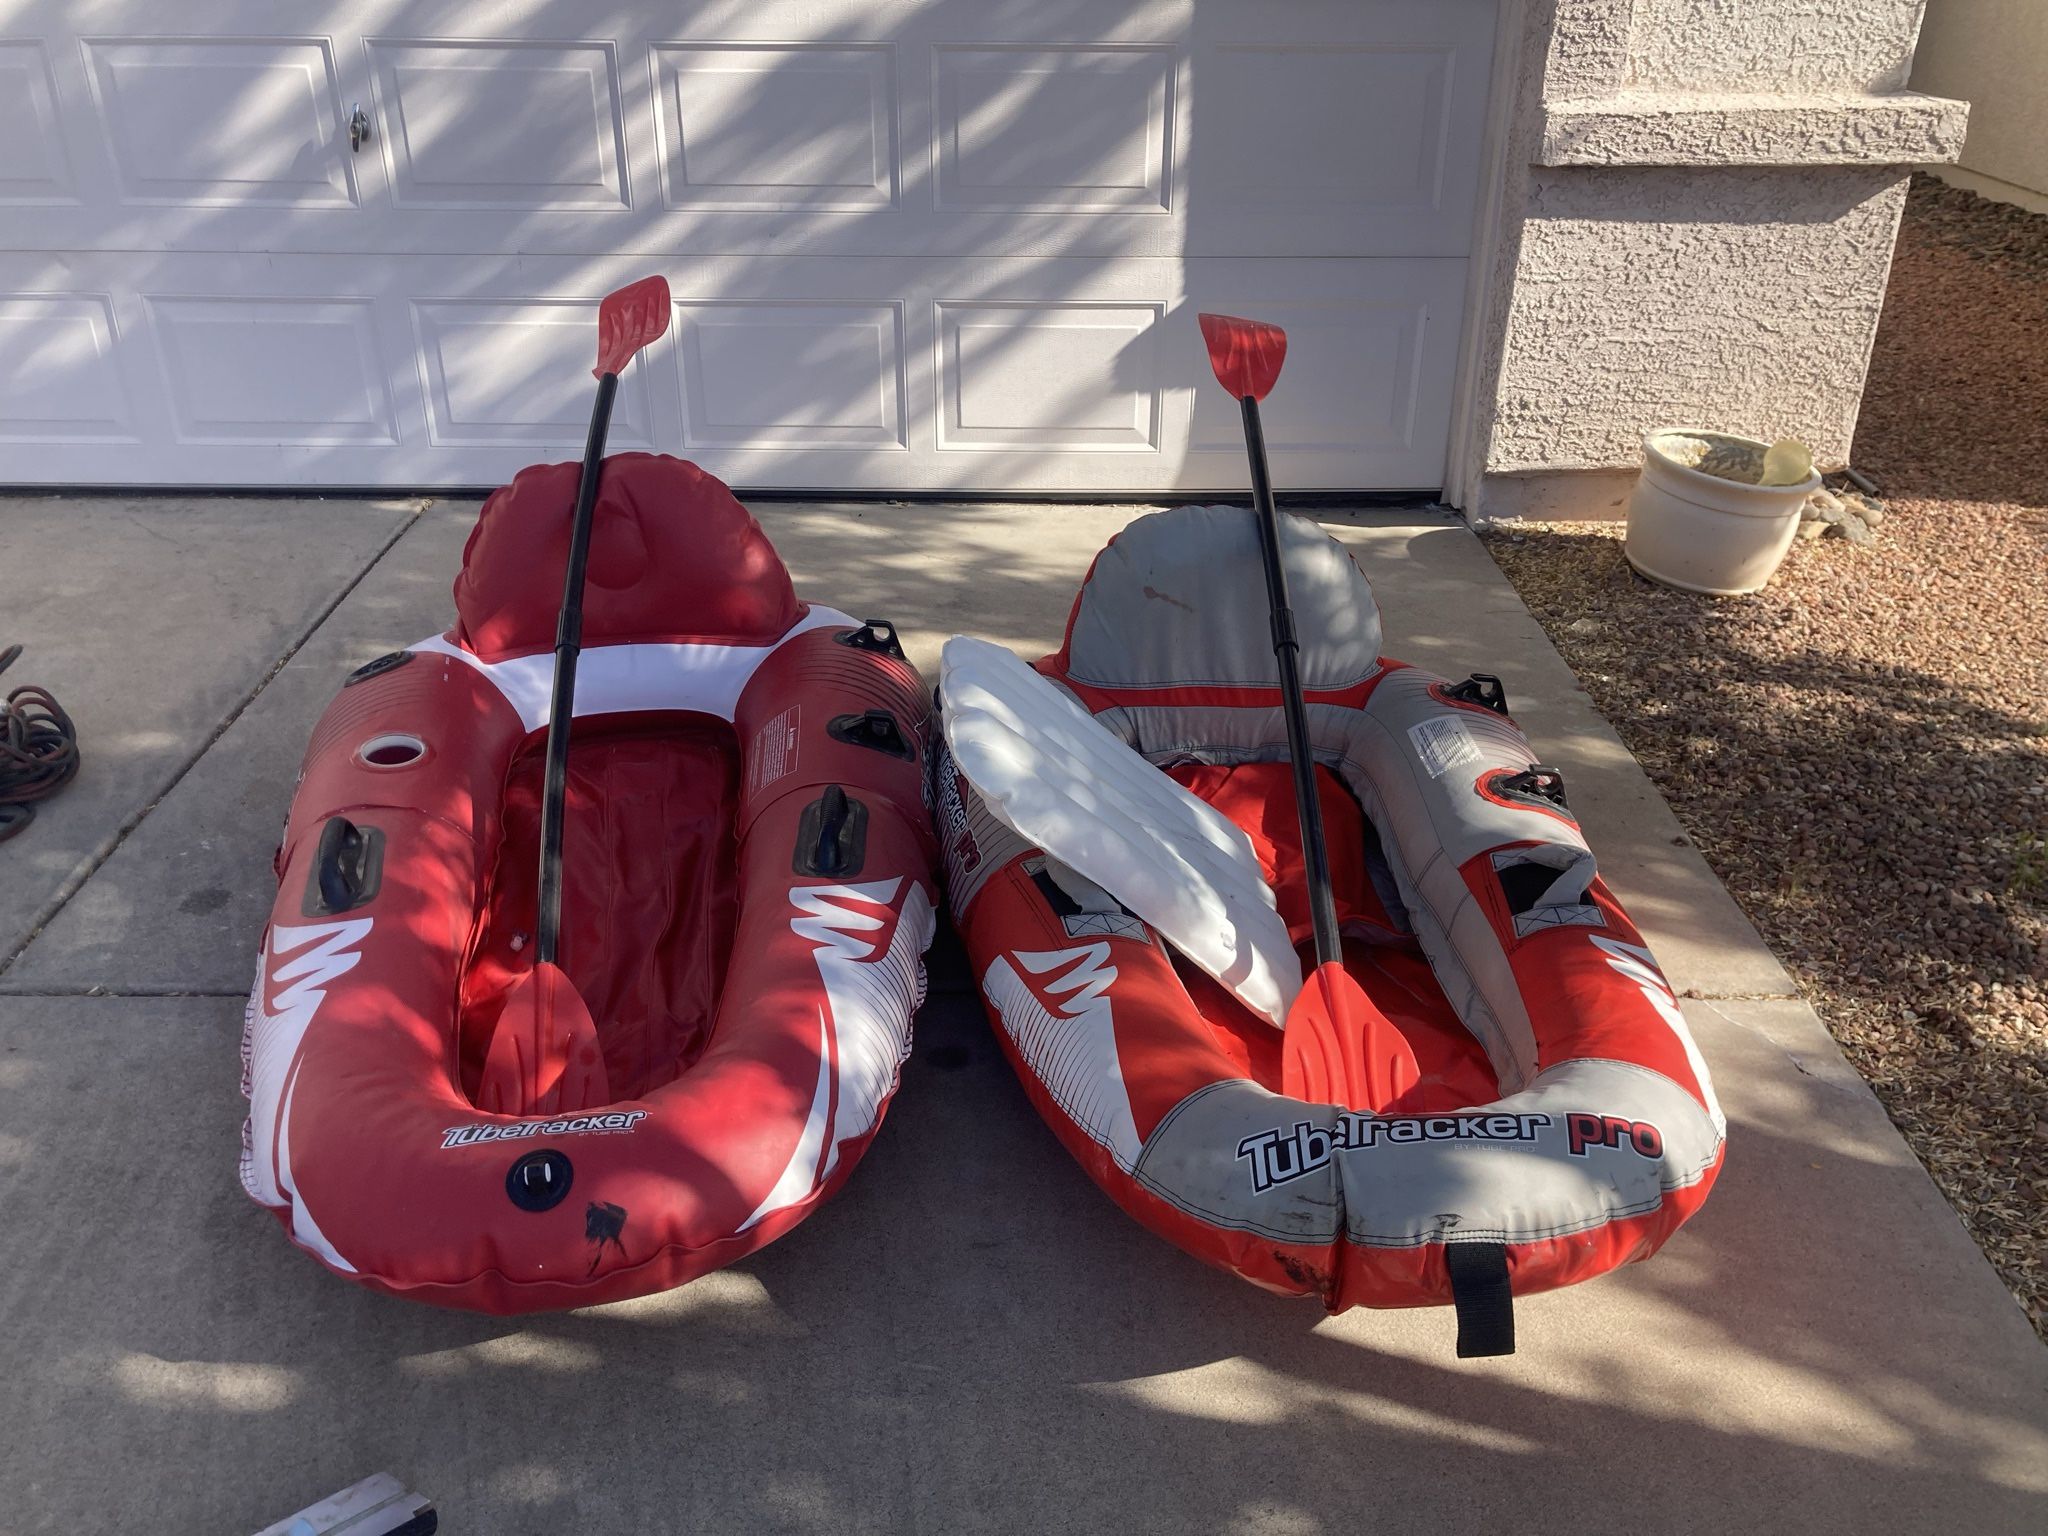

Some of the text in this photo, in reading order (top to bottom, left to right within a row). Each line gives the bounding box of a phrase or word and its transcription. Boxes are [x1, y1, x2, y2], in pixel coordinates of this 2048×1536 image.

[441, 1110, 647, 1149] TubeTracker
[1454, 1143, 1470, 1151] BY
[1564, 1111, 1664, 1160] pro
